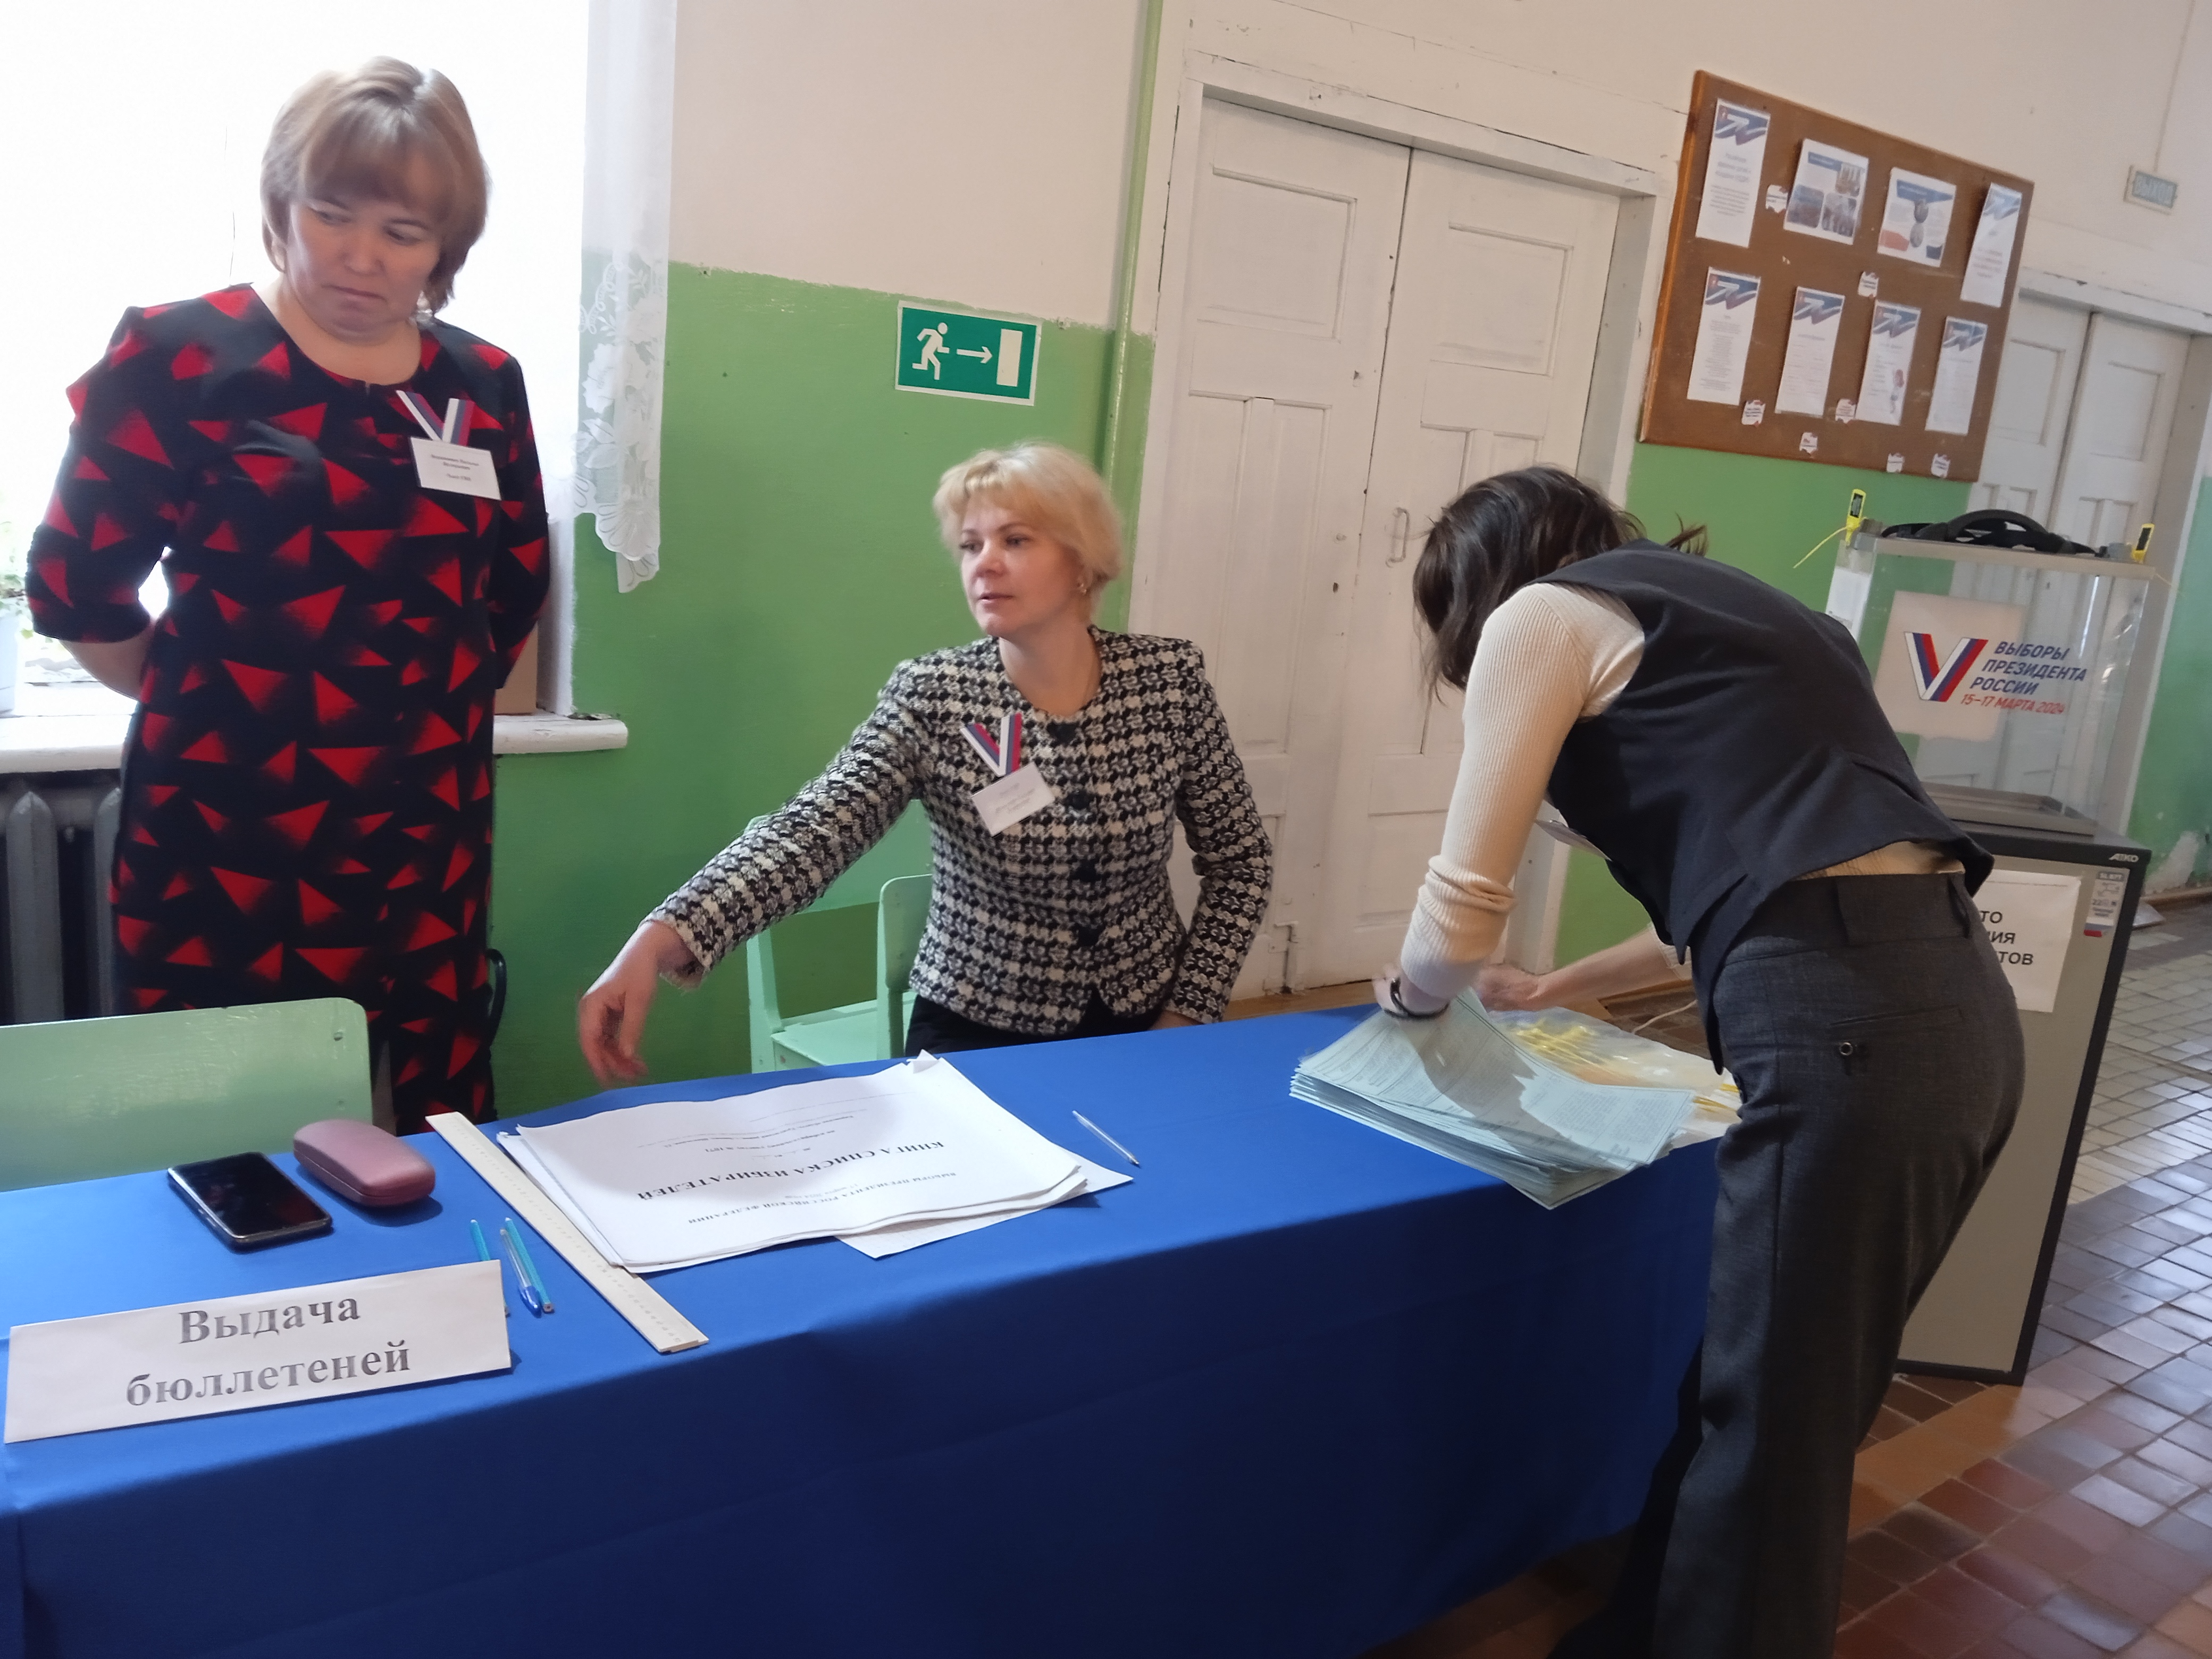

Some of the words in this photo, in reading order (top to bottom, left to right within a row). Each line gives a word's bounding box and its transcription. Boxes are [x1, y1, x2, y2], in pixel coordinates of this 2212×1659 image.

[1994, 641, 2070, 660] ВЫБОРЫ
[1982, 659, 2088, 681] ПРЕЗИДЕНТА
[1970, 676, 2039, 695] РОССИИ
[1995, 697, 2035, 711] МАРТА
[2035, 701, 2066, 715] 2024
[1979, 910, 2002, 924] ТО
[1988, 931, 2016, 944] ИЯ
[1998, 951, 2033, 965] ТОВ
[880, 1142, 944, 1154] КНИГА
[793, 1150, 876, 1175] СПИСКА
[638, 1170, 789, 1200] ИЗБИРАТЕЛЕЙ
[912, 1172, 957, 1182] ВЫБОРЫ
[841, 1178, 910, 1197] ПРЕЗИДЕНТА
[178, 1296, 361, 1345] Выдача
[125, 1339, 412, 1406] бюллетеней
